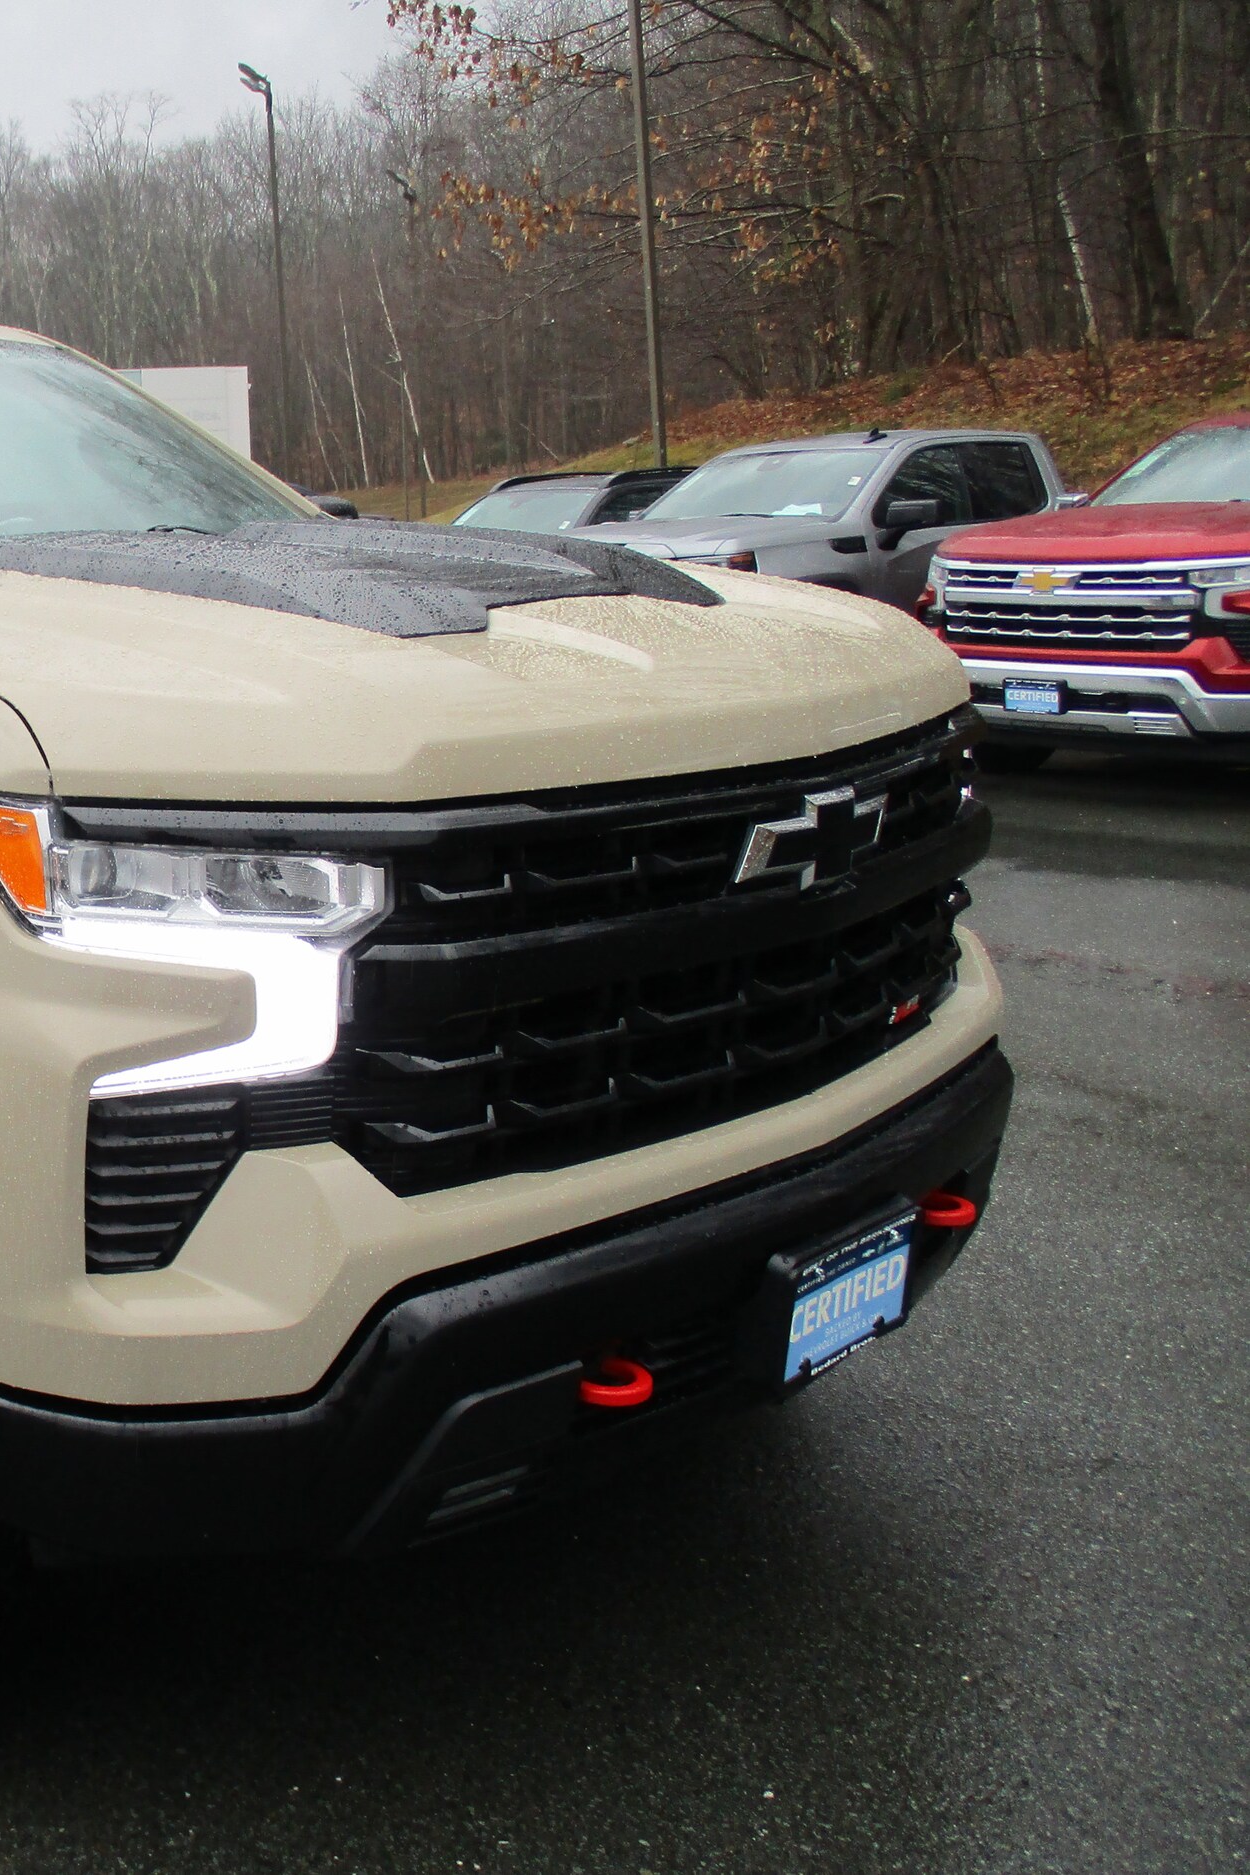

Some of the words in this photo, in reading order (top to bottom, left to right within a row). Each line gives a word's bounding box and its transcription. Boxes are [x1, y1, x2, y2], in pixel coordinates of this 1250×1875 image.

[1007, 690, 1058, 703] CERTIFIED
[790, 1254, 906, 1344] CERTIFIED
[811, 1350, 847, 1376] Bedard
